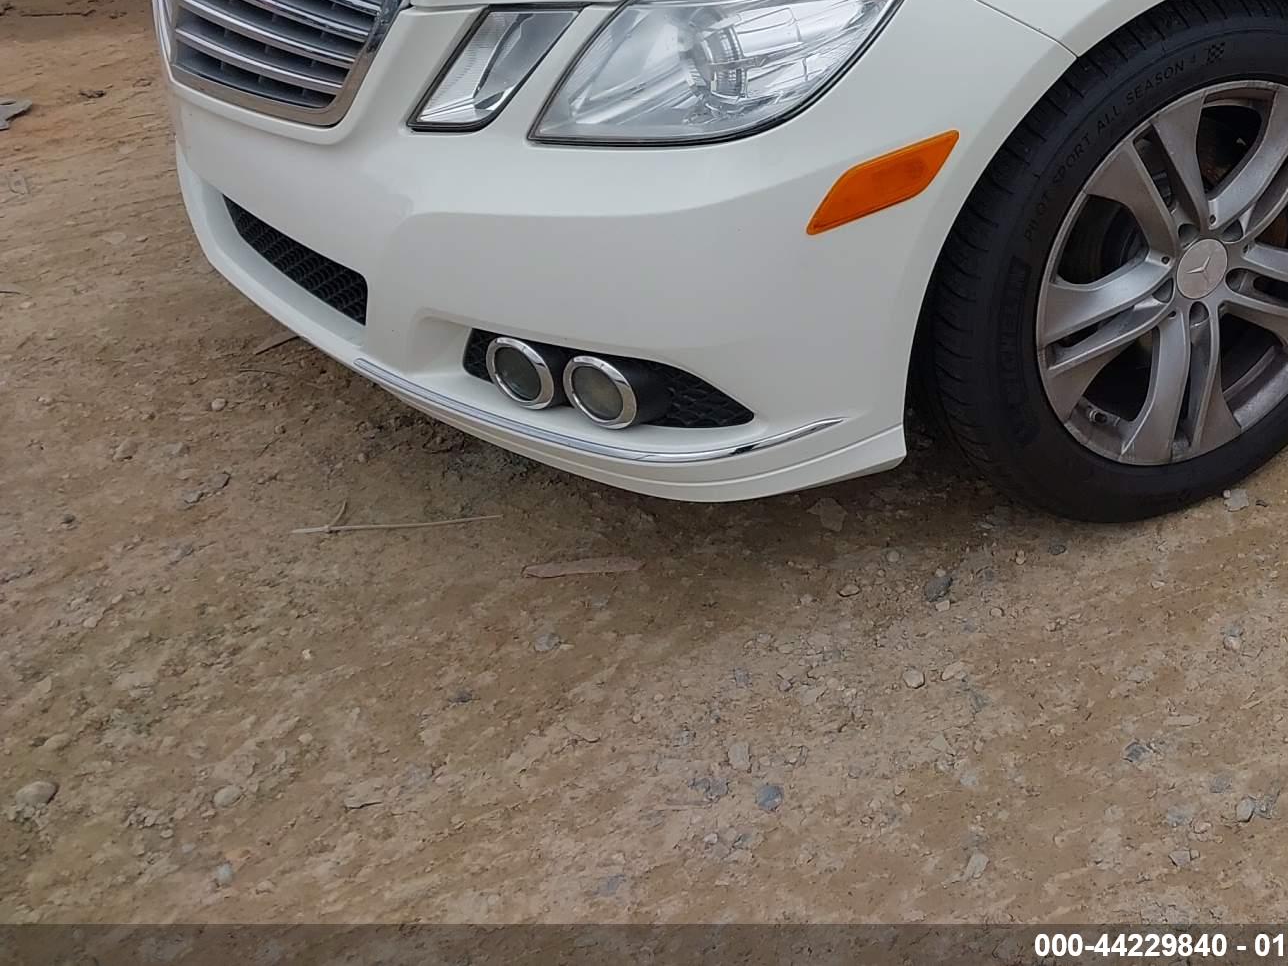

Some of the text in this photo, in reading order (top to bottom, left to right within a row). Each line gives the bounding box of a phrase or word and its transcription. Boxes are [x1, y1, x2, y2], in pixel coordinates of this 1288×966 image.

[1025, 191, 1050, 242] PILOT
[1053, 133, 1091, 184] SPORT
[1096, 105, 1121, 131] ALL
[1125, 59, 1185, 105] SEASON
